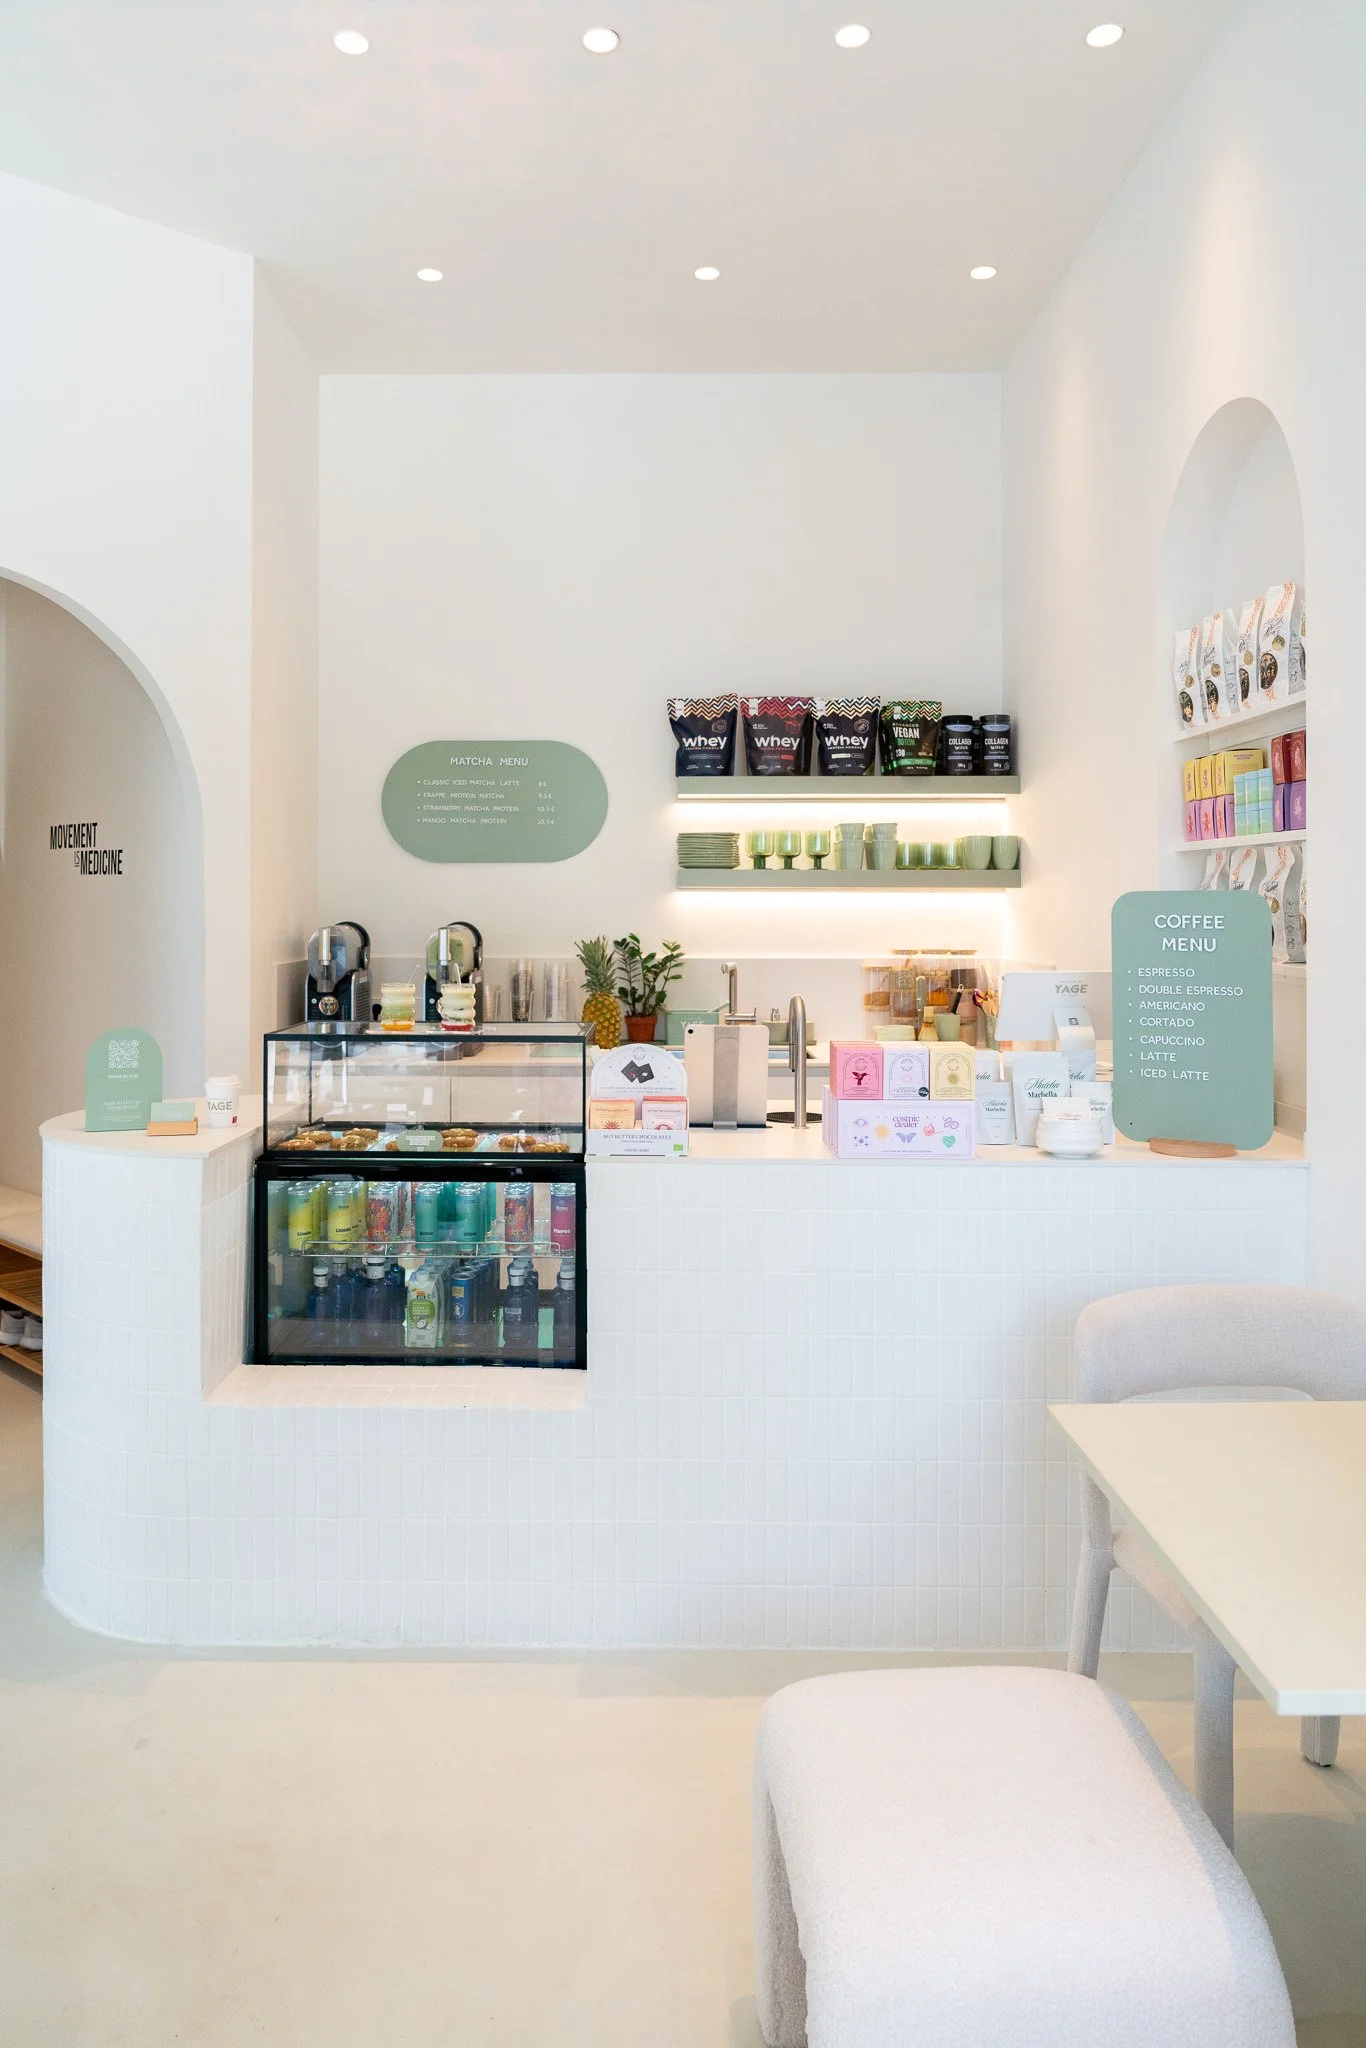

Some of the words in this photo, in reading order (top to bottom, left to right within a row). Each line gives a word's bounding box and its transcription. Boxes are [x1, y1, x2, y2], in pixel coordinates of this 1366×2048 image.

[892, 727, 920, 739] VEGAN
[682, 735, 728, 750] whey
[754, 734, 800, 750] whey
[825, 734, 869, 749] whey
[984, 737, 1009, 745] COLLAGEN
[450, 757, 493, 766] MATCHA
[500, 757, 529, 766] MENU
[50, 822, 98, 850] MOVEMENT
[80, 849, 123, 875] MEDICINE
[1154, 914, 1225, 929] COFFEE
[1162, 937, 1217, 952] MENU
[1138, 968, 1195, 978] ESPRESSO
[1054, 984, 1088, 994] YAGE
[1139, 985, 1183, 995] DOUBLE
[1186, 986, 1243, 997] ESPRESSO
[1139, 1001, 1205, 1012] AMERICANO
[1139, 1017, 1195, 1028] CORTADO
[1140, 1035, 1205, 1046] CAPUCCINO
[1140, 1051, 1177, 1062] LATTE
[975, 1071, 991, 1080] tcha
[1069, 1071, 1085, 1080] tcha
[1140, 1068, 1167, 1079] ICED
[1172, 1070, 1210, 1081] LATTE
[1024, 1077, 1061, 1090] Matcha
[892, 1114, 920, 1122] cosmic
